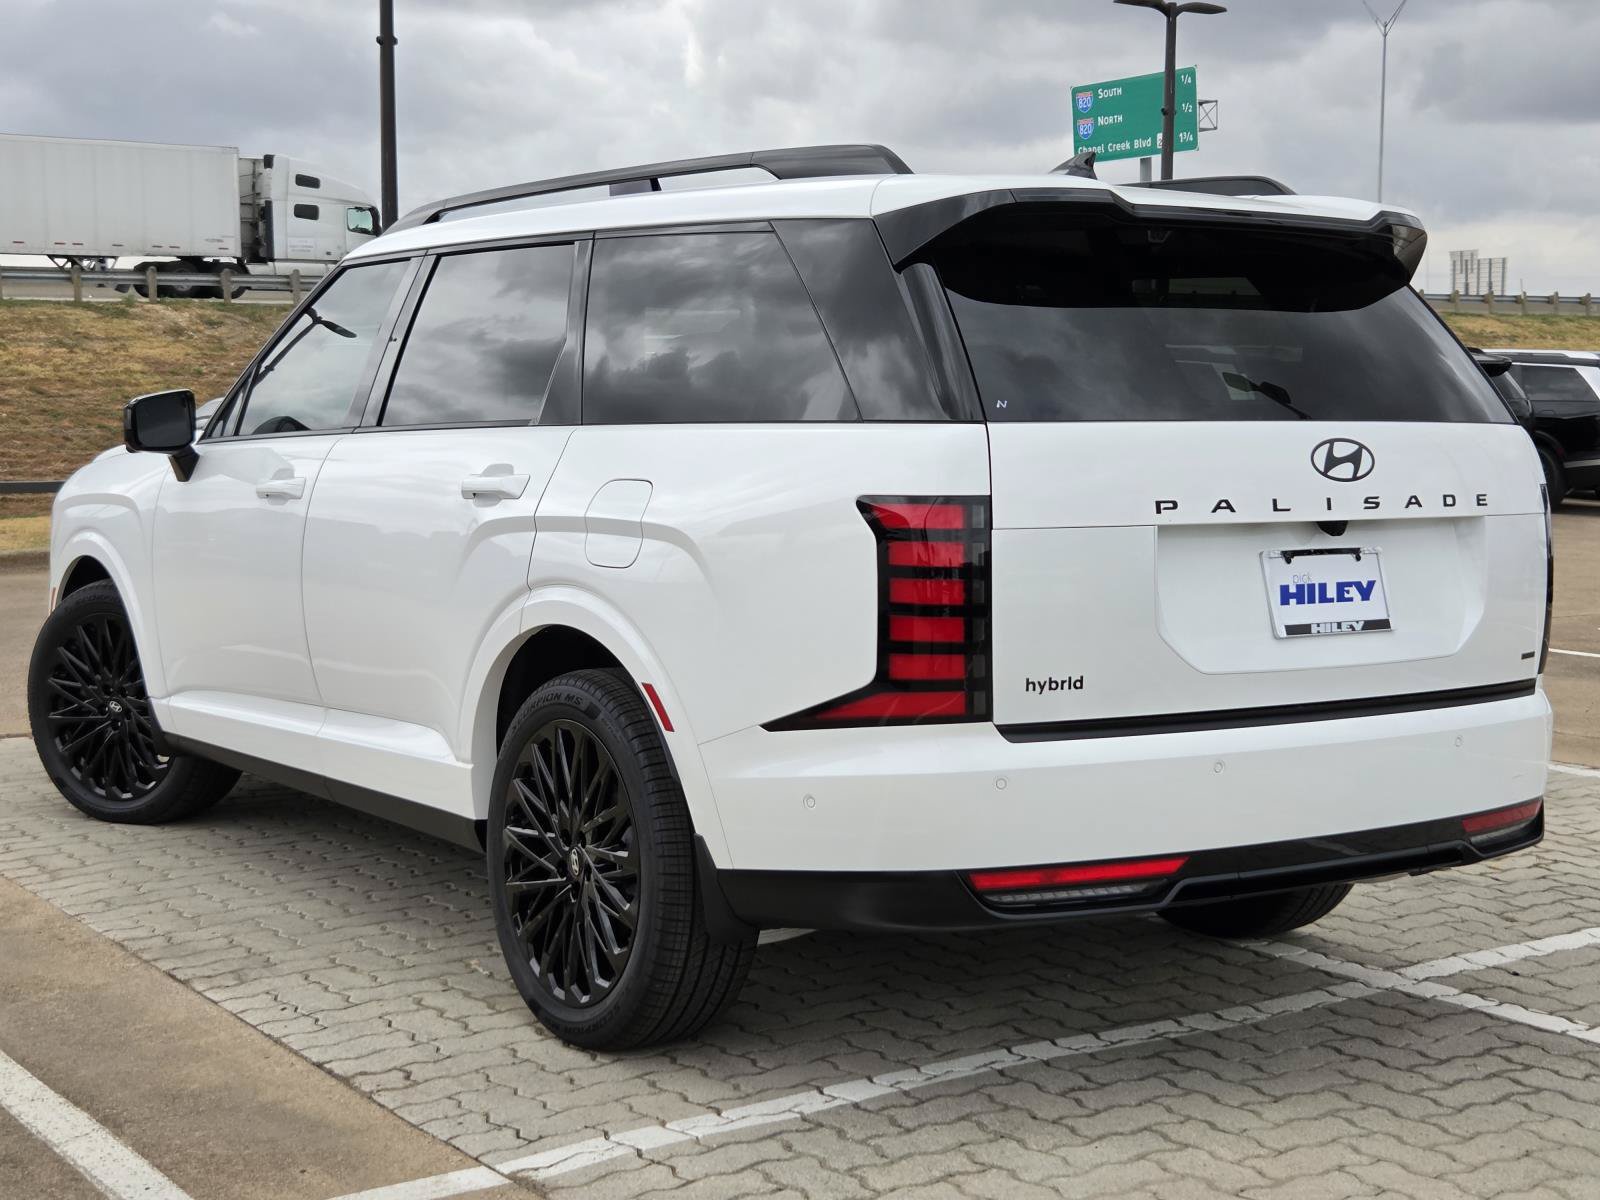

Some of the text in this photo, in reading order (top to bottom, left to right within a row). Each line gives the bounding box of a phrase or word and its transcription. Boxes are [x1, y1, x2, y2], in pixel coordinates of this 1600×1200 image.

[1078, 96, 1092, 108] 820
[1079, 123, 1092, 135] 820
[1107, 140, 1131, 152] Creek
[1134, 137, 1151, 149] Blvd
[1155, 493, 1489, 515] PALISADE
[1279, 580, 1377, 606] HILEY
[1310, 620, 1365, 634] HILEY
[1025, 675, 1084, 695] hybrid
